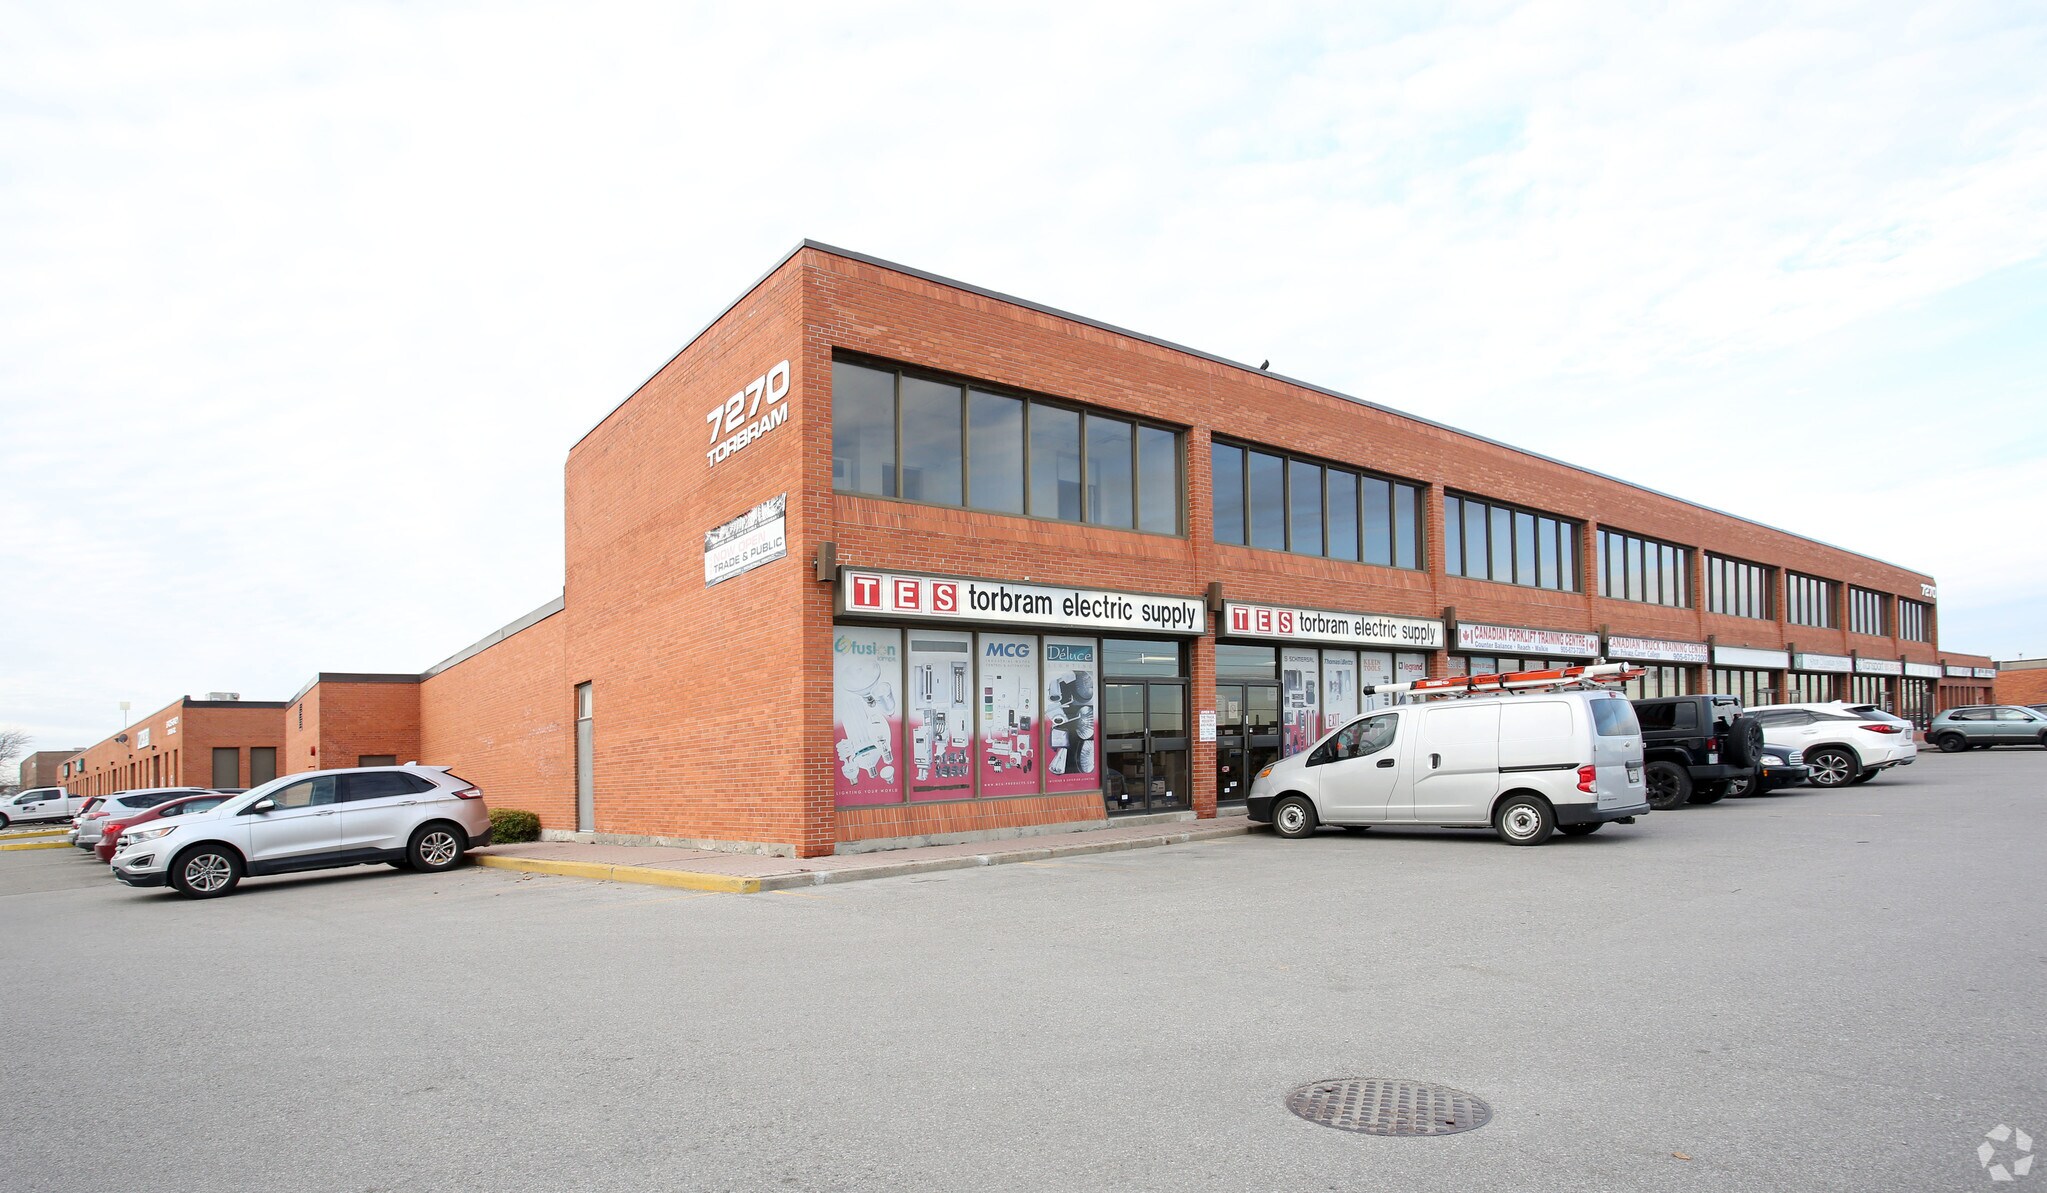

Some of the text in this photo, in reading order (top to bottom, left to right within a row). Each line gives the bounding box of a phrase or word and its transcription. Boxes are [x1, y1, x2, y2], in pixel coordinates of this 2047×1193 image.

[706, 359, 790, 445] 7270
[706, 402, 788, 468] TORBRAM
[714, 530, 766, 563] NOW OPEN
[714, 536, 783, 574] TRADE & PUBLIC
[969, 583, 1052, 615] torbram
[1062, 592, 1133, 621] electric
[1142, 602, 1196, 629] supply
[1299, 611, 1349, 635] torbram
[1355, 617, 1397, 638] electric
[1402, 623, 1436, 645] supply
[1474, 625, 1586, 647] CANADIAN FORKLIFT TRAINING CENTRE
[986, 642, 1030, 658] MCG
[1047, 645, 1092, 661] Déluce
[1474, 640, 1494, 648] Counter
[1608, 637, 1708, 655] CANADIAN TRUCK TRAINING CENTRE
[1403, 662, 1423, 672] legrand
